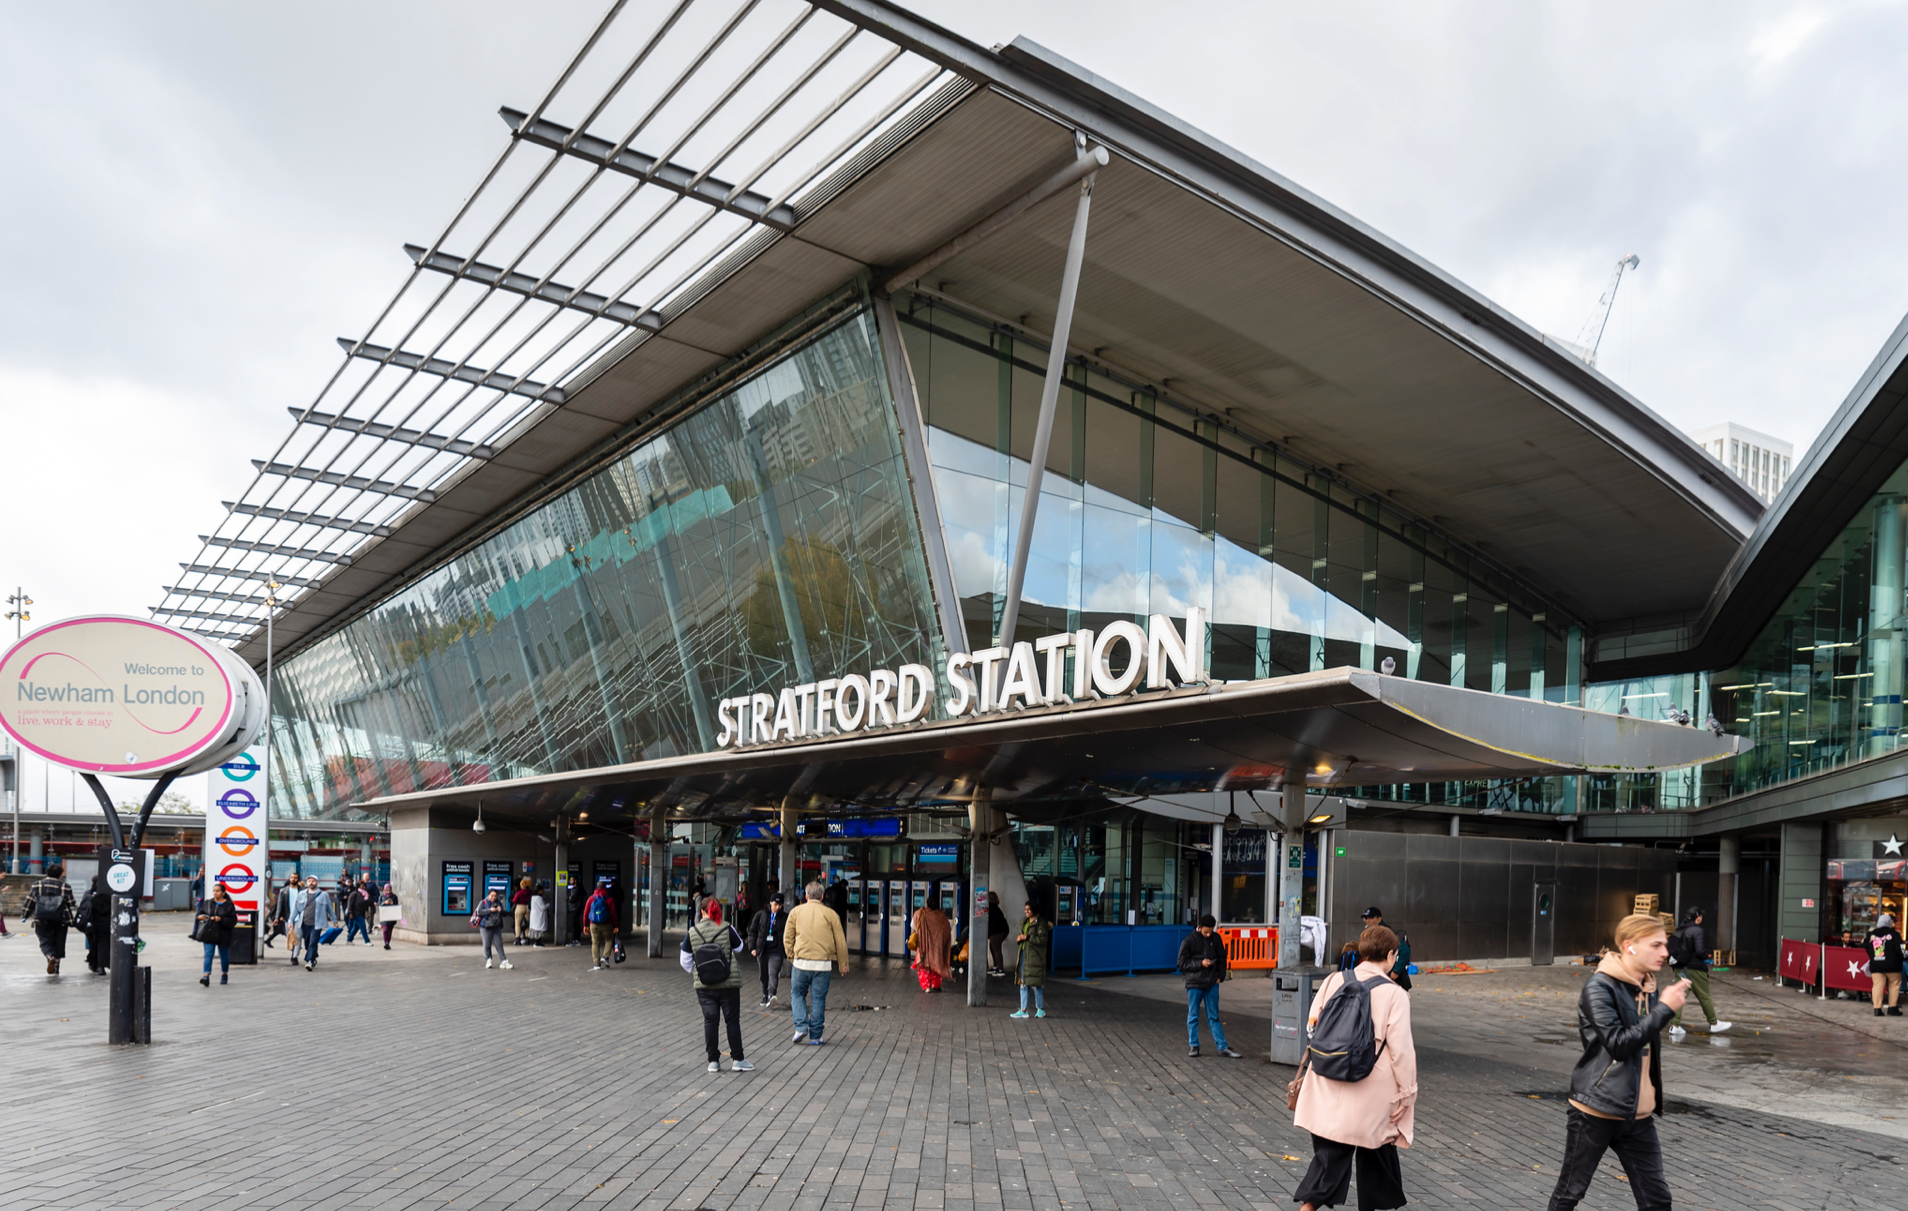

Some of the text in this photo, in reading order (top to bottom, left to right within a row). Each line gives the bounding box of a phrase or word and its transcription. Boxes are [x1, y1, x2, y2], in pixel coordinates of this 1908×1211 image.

[125, 663, 204, 676] Welcome to
[716, 606, 1206, 746] STRATFORD STATION
[18, 682, 205, 705] Newham London
[42, 716, 73, 726] work
[75, 718, 85, 727] &
[87, 718, 112, 729] stay
[1223, 834, 1256, 846] ational
[921, 846, 937, 854] Tickets
[113, 871, 129, 879] GREAT
